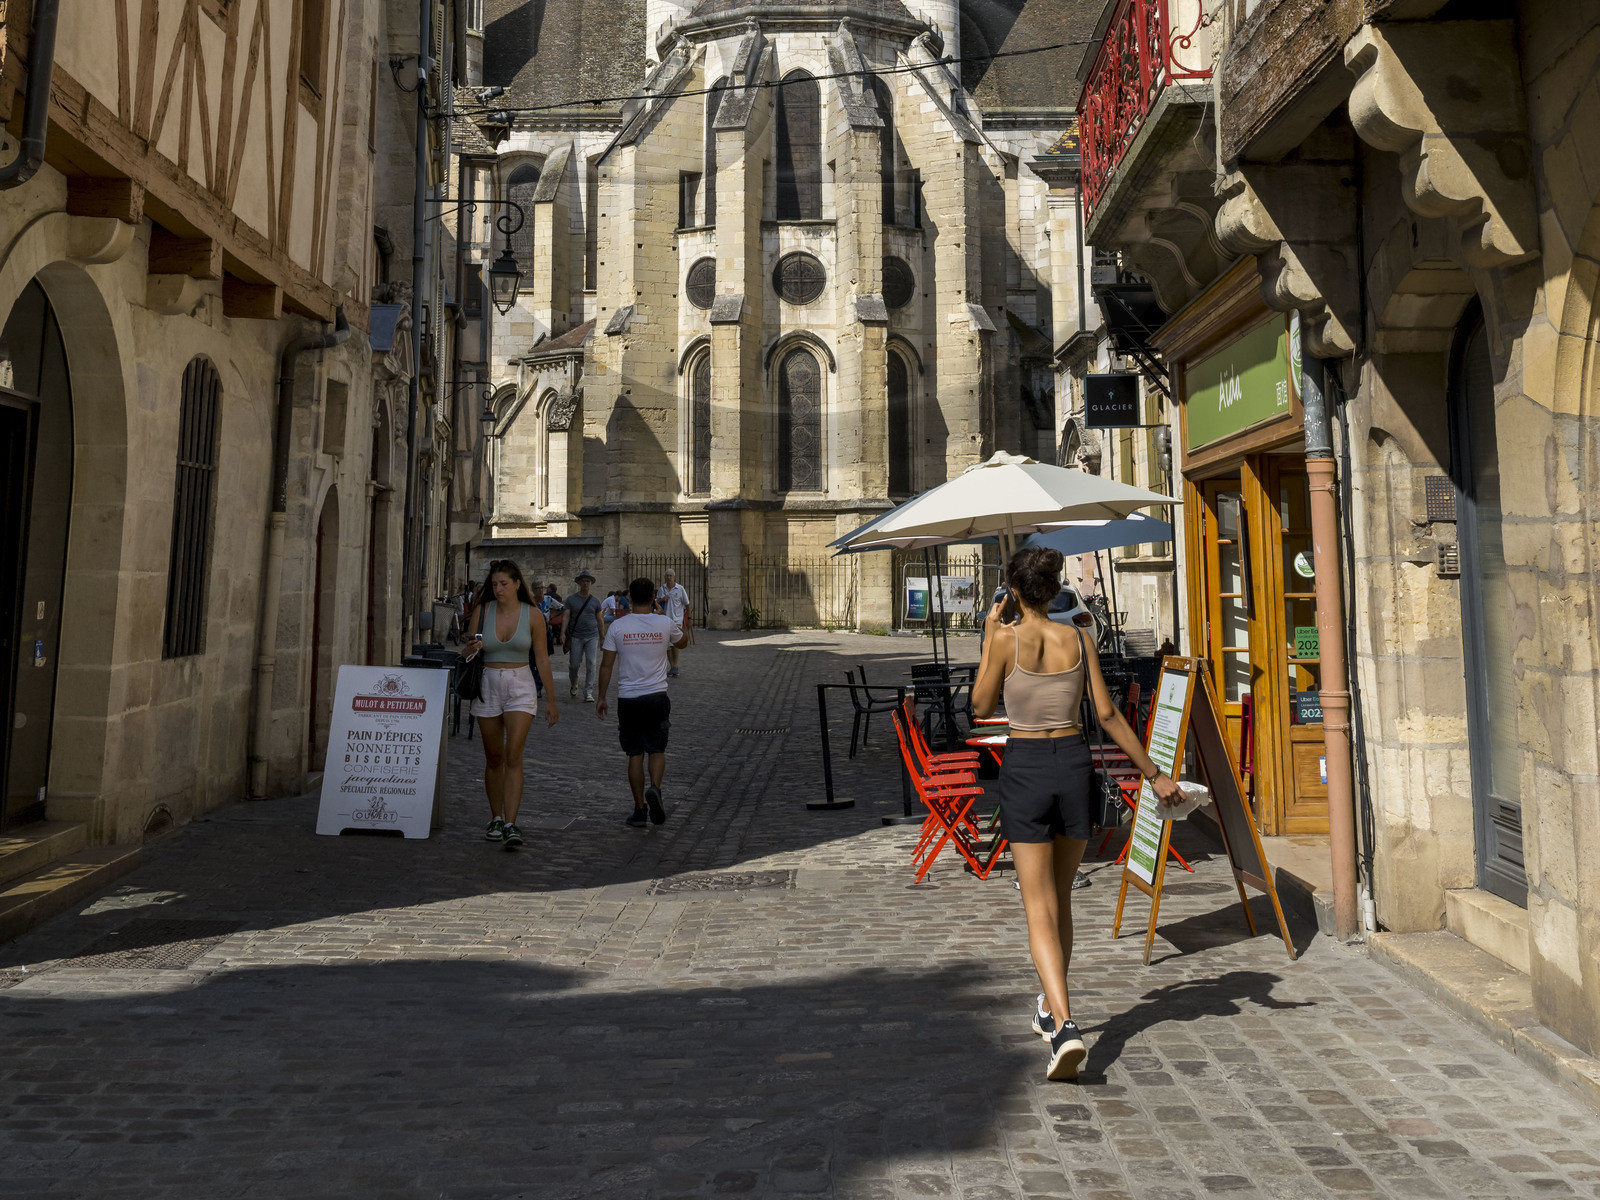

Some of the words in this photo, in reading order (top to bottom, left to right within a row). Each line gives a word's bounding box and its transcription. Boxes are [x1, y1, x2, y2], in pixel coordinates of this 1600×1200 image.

[1091, 404, 1133, 412] GLACIER
[355, 699, 379, 709] MULOT
[380, 701, 386, 709] &
[387, 701, 424, 711] PETITJEAN
[347, 730, 372, 740] PAIN
[375, 730, 423, 742] D'ÉPICES
[346, 743, 422, 755] NONNETTES
[345, 755, 420, 765] BISCUITS
[344, 764, 419, 775] CONFISERIE
[340, 785, 377, 794] SPÉCIALITÉS
[379, 786, 416, 795] RÉGIONALES
